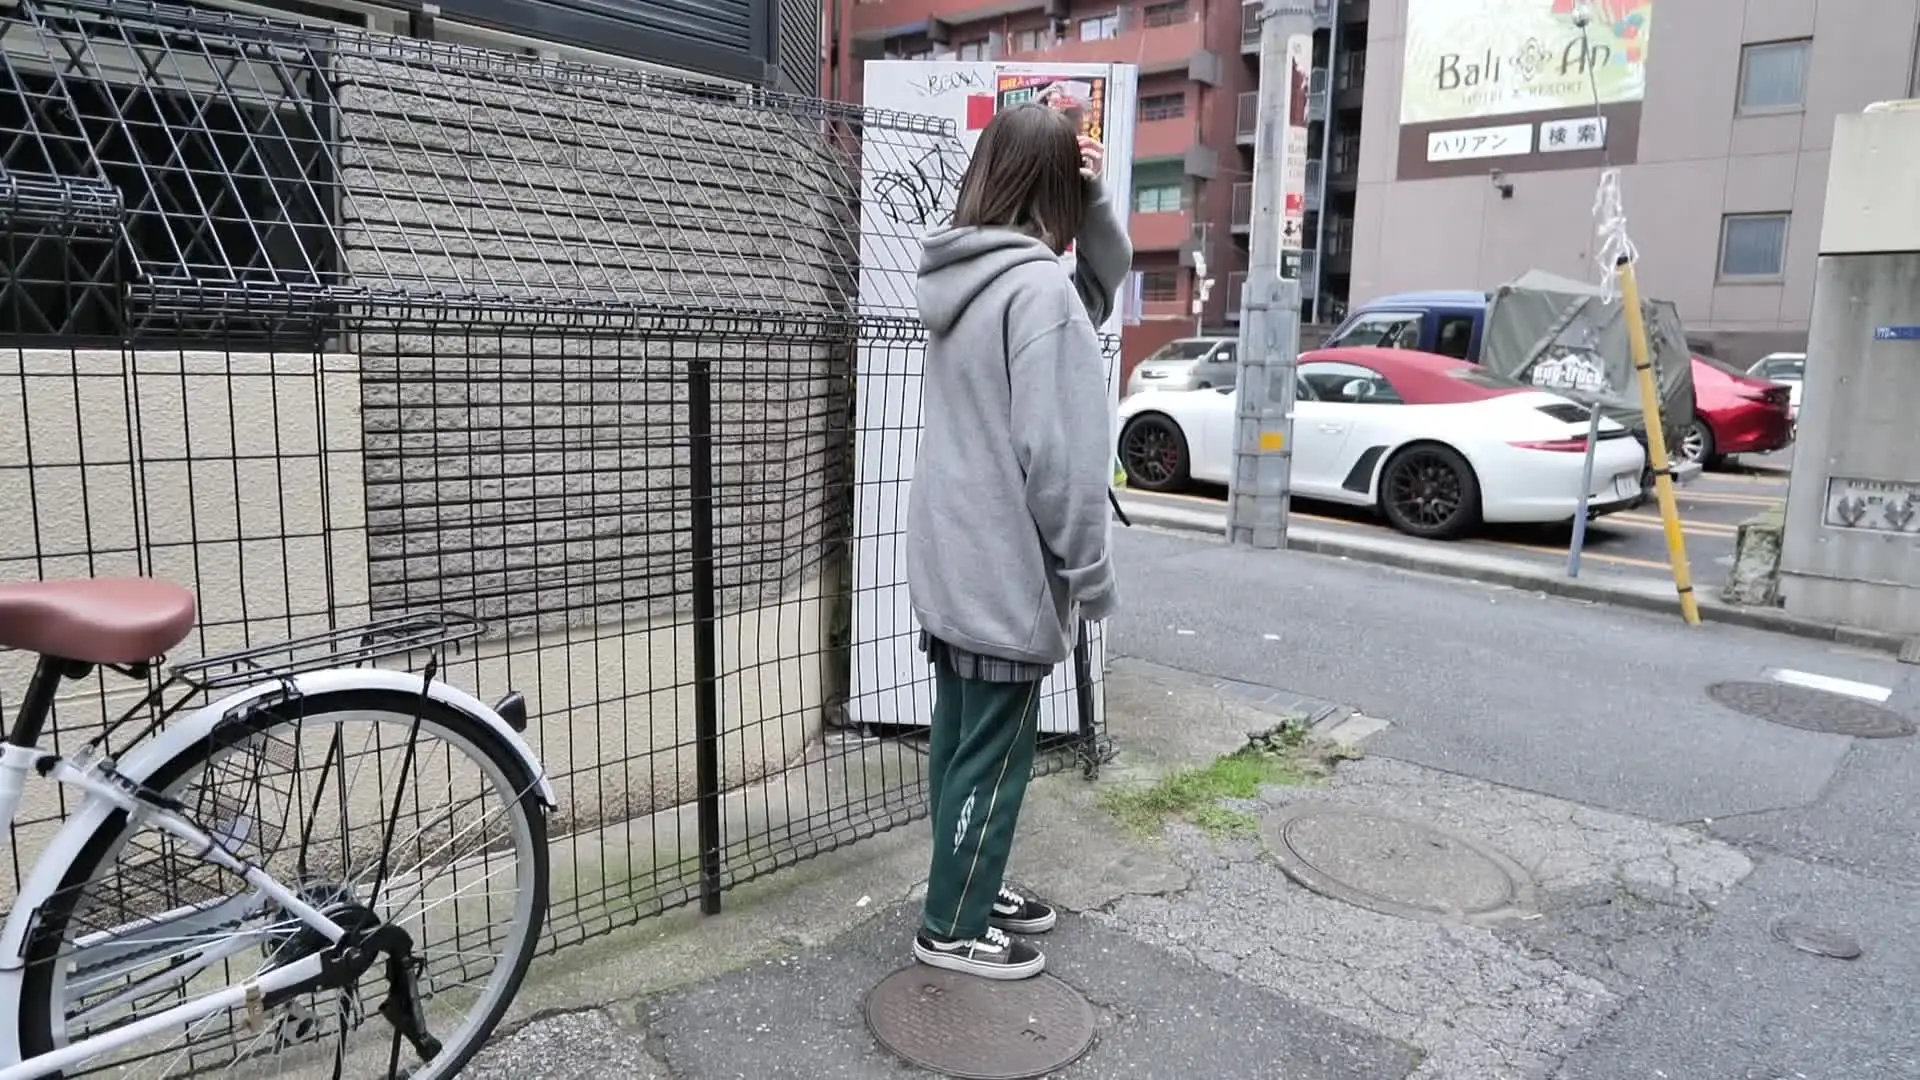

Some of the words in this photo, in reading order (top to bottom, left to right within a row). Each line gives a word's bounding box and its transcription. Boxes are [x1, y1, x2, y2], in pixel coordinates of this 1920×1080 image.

[1437, 48, 1500, 91] Bali
[1561, 37, 1610, 75] An
[1549, 124, 1596, 145] 検索
